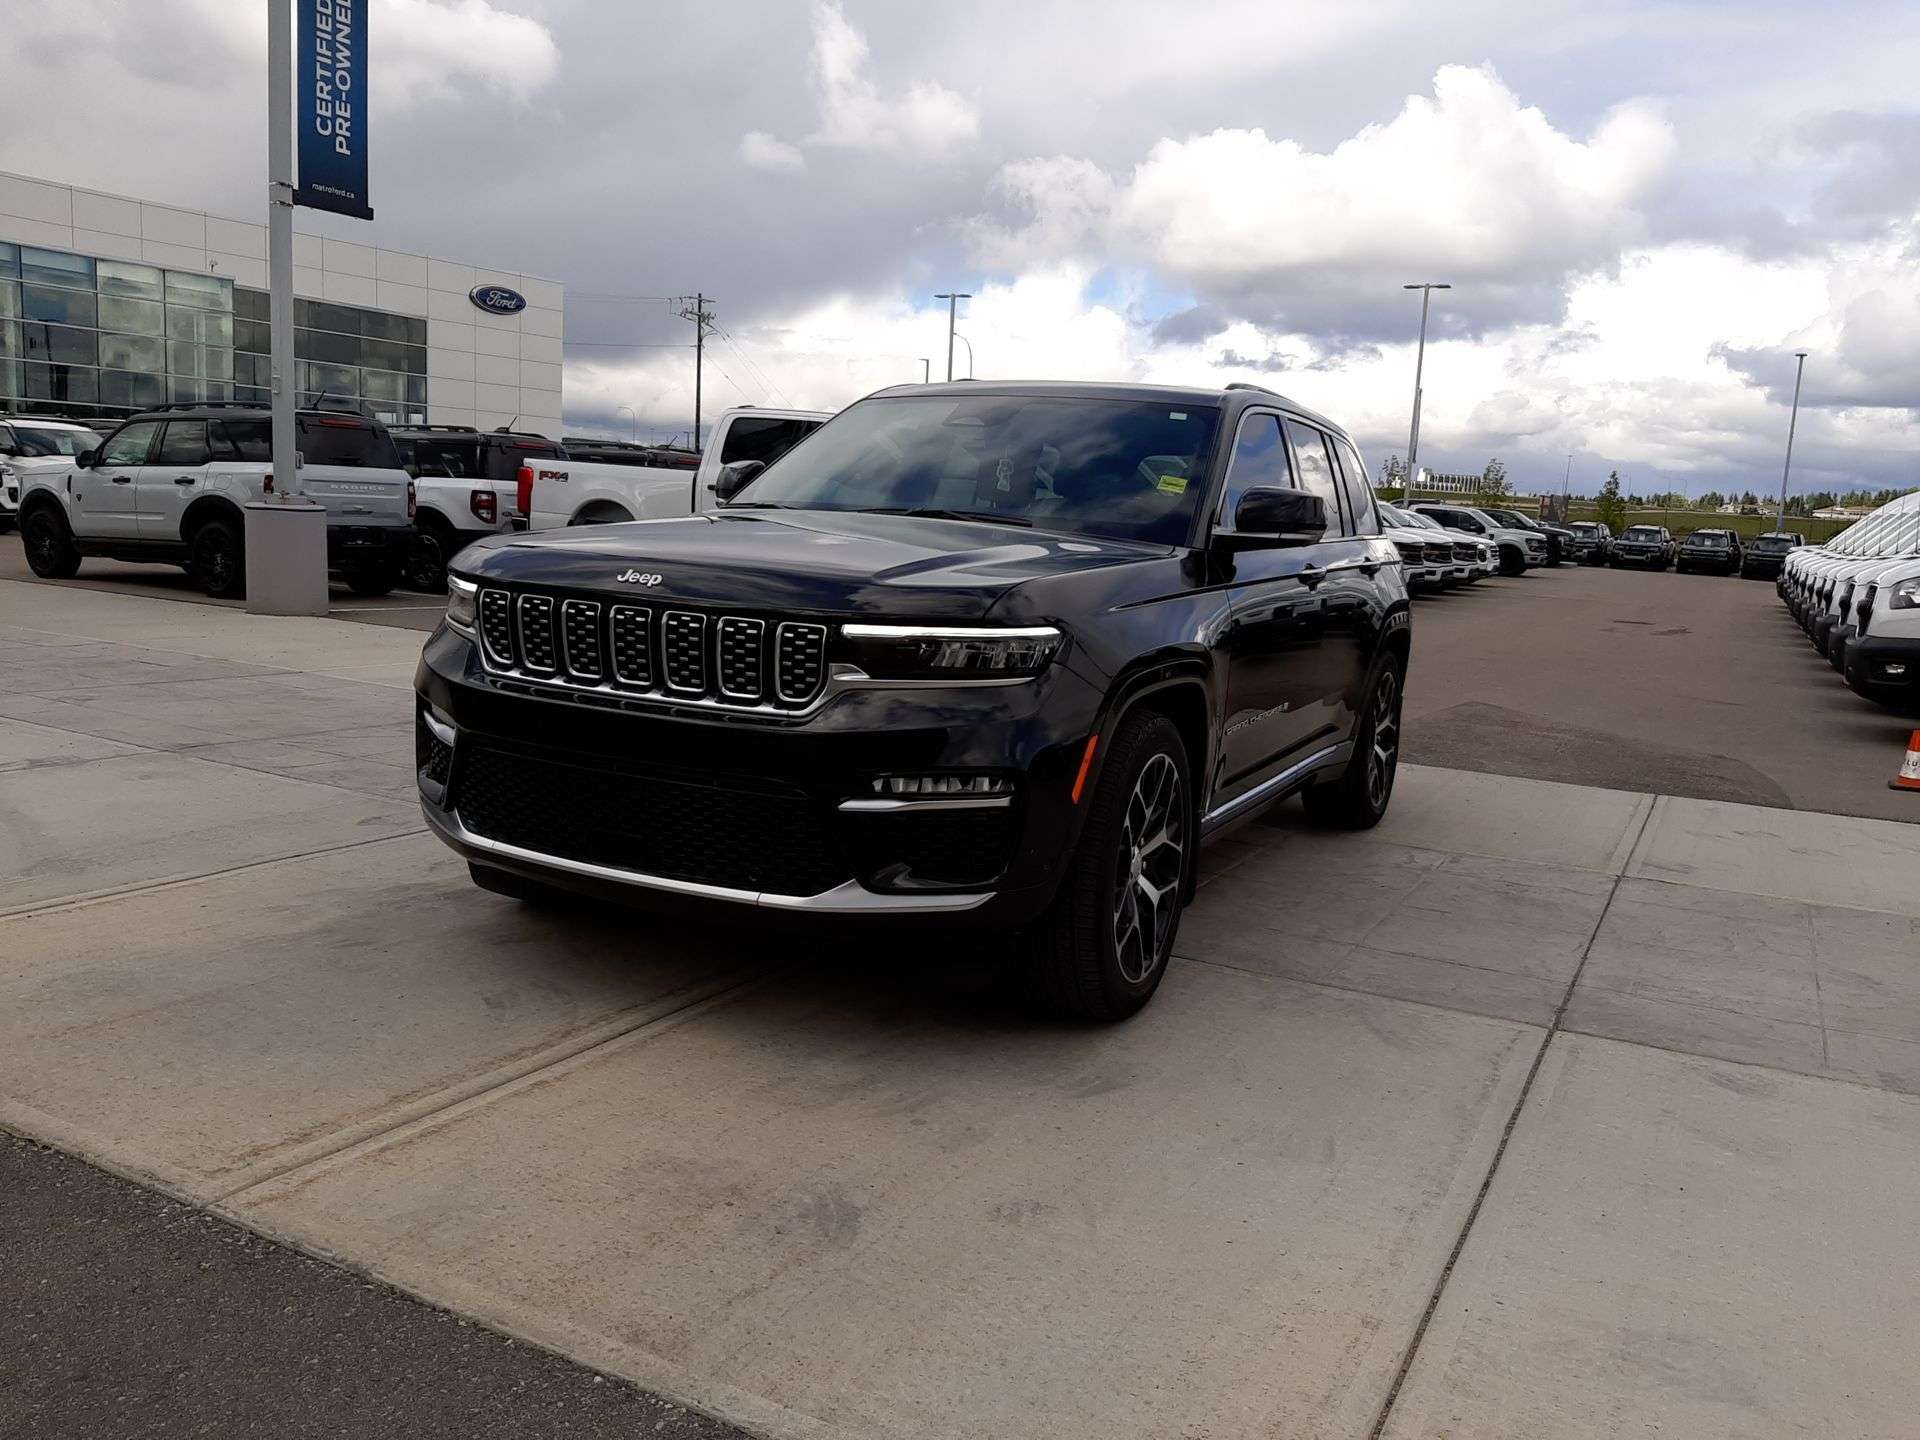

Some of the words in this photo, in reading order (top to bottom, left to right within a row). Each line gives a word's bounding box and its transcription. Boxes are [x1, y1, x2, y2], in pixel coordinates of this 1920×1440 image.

[316, 0, 332, 136] CERTIFIED
[486, 290, 517, 309] Ford
[616, 569, 663, 587] Jeep
